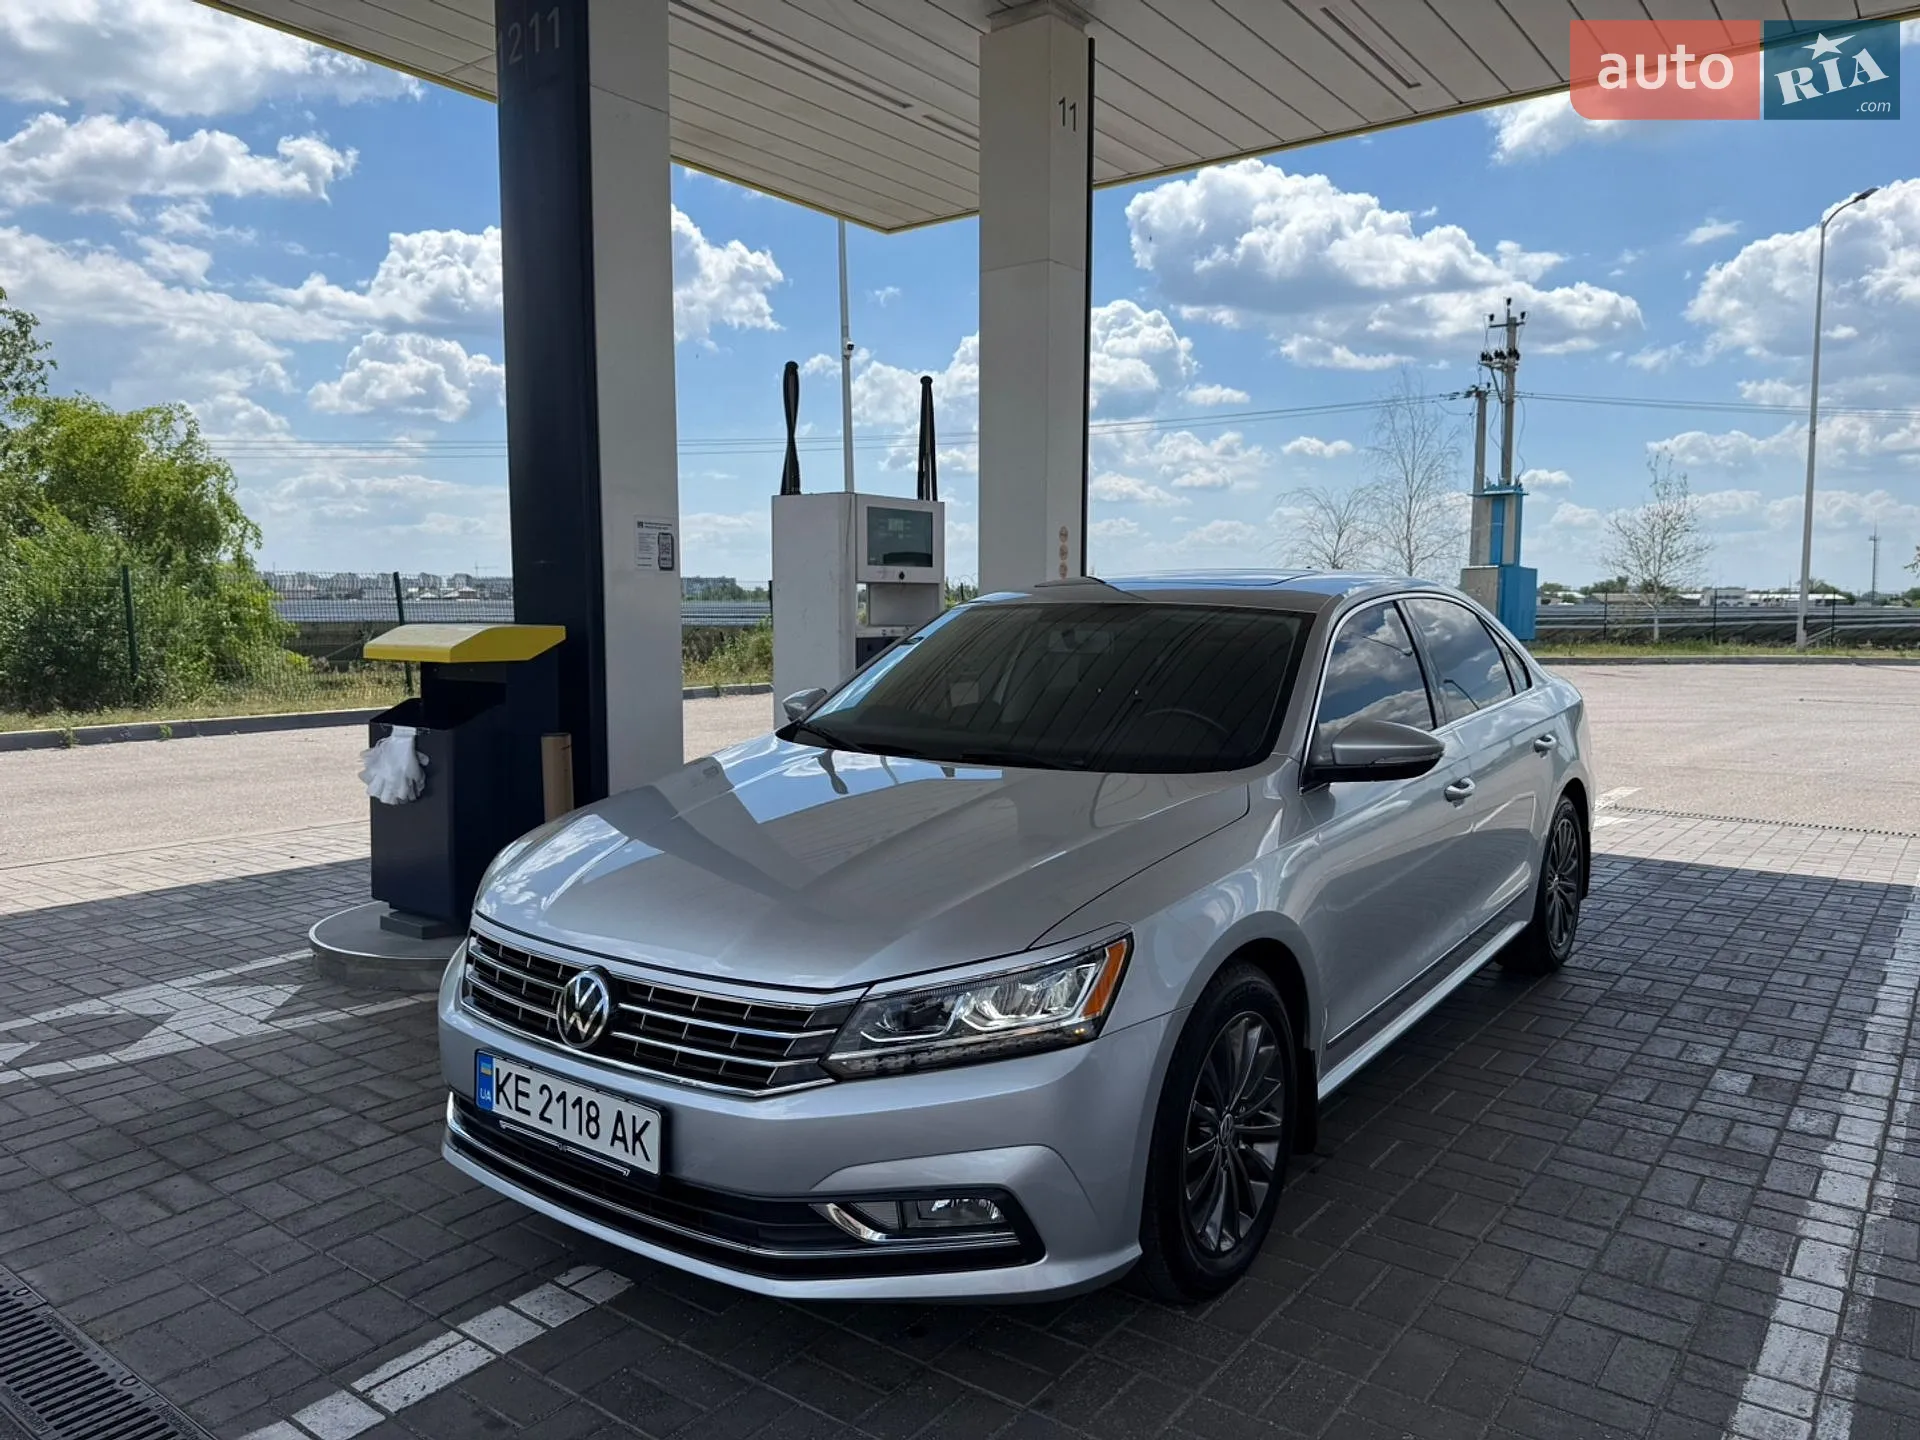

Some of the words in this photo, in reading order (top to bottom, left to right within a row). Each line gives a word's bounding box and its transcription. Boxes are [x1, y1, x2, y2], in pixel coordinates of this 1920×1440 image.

[1058, 97, 1077, 132] 11
[480, 1087, 492, 1102] UA
[495, 1067, 531, 1116] KE
[538, 1084, 601, 1140] 2118
[609, 1109, 651, 1162] AK
